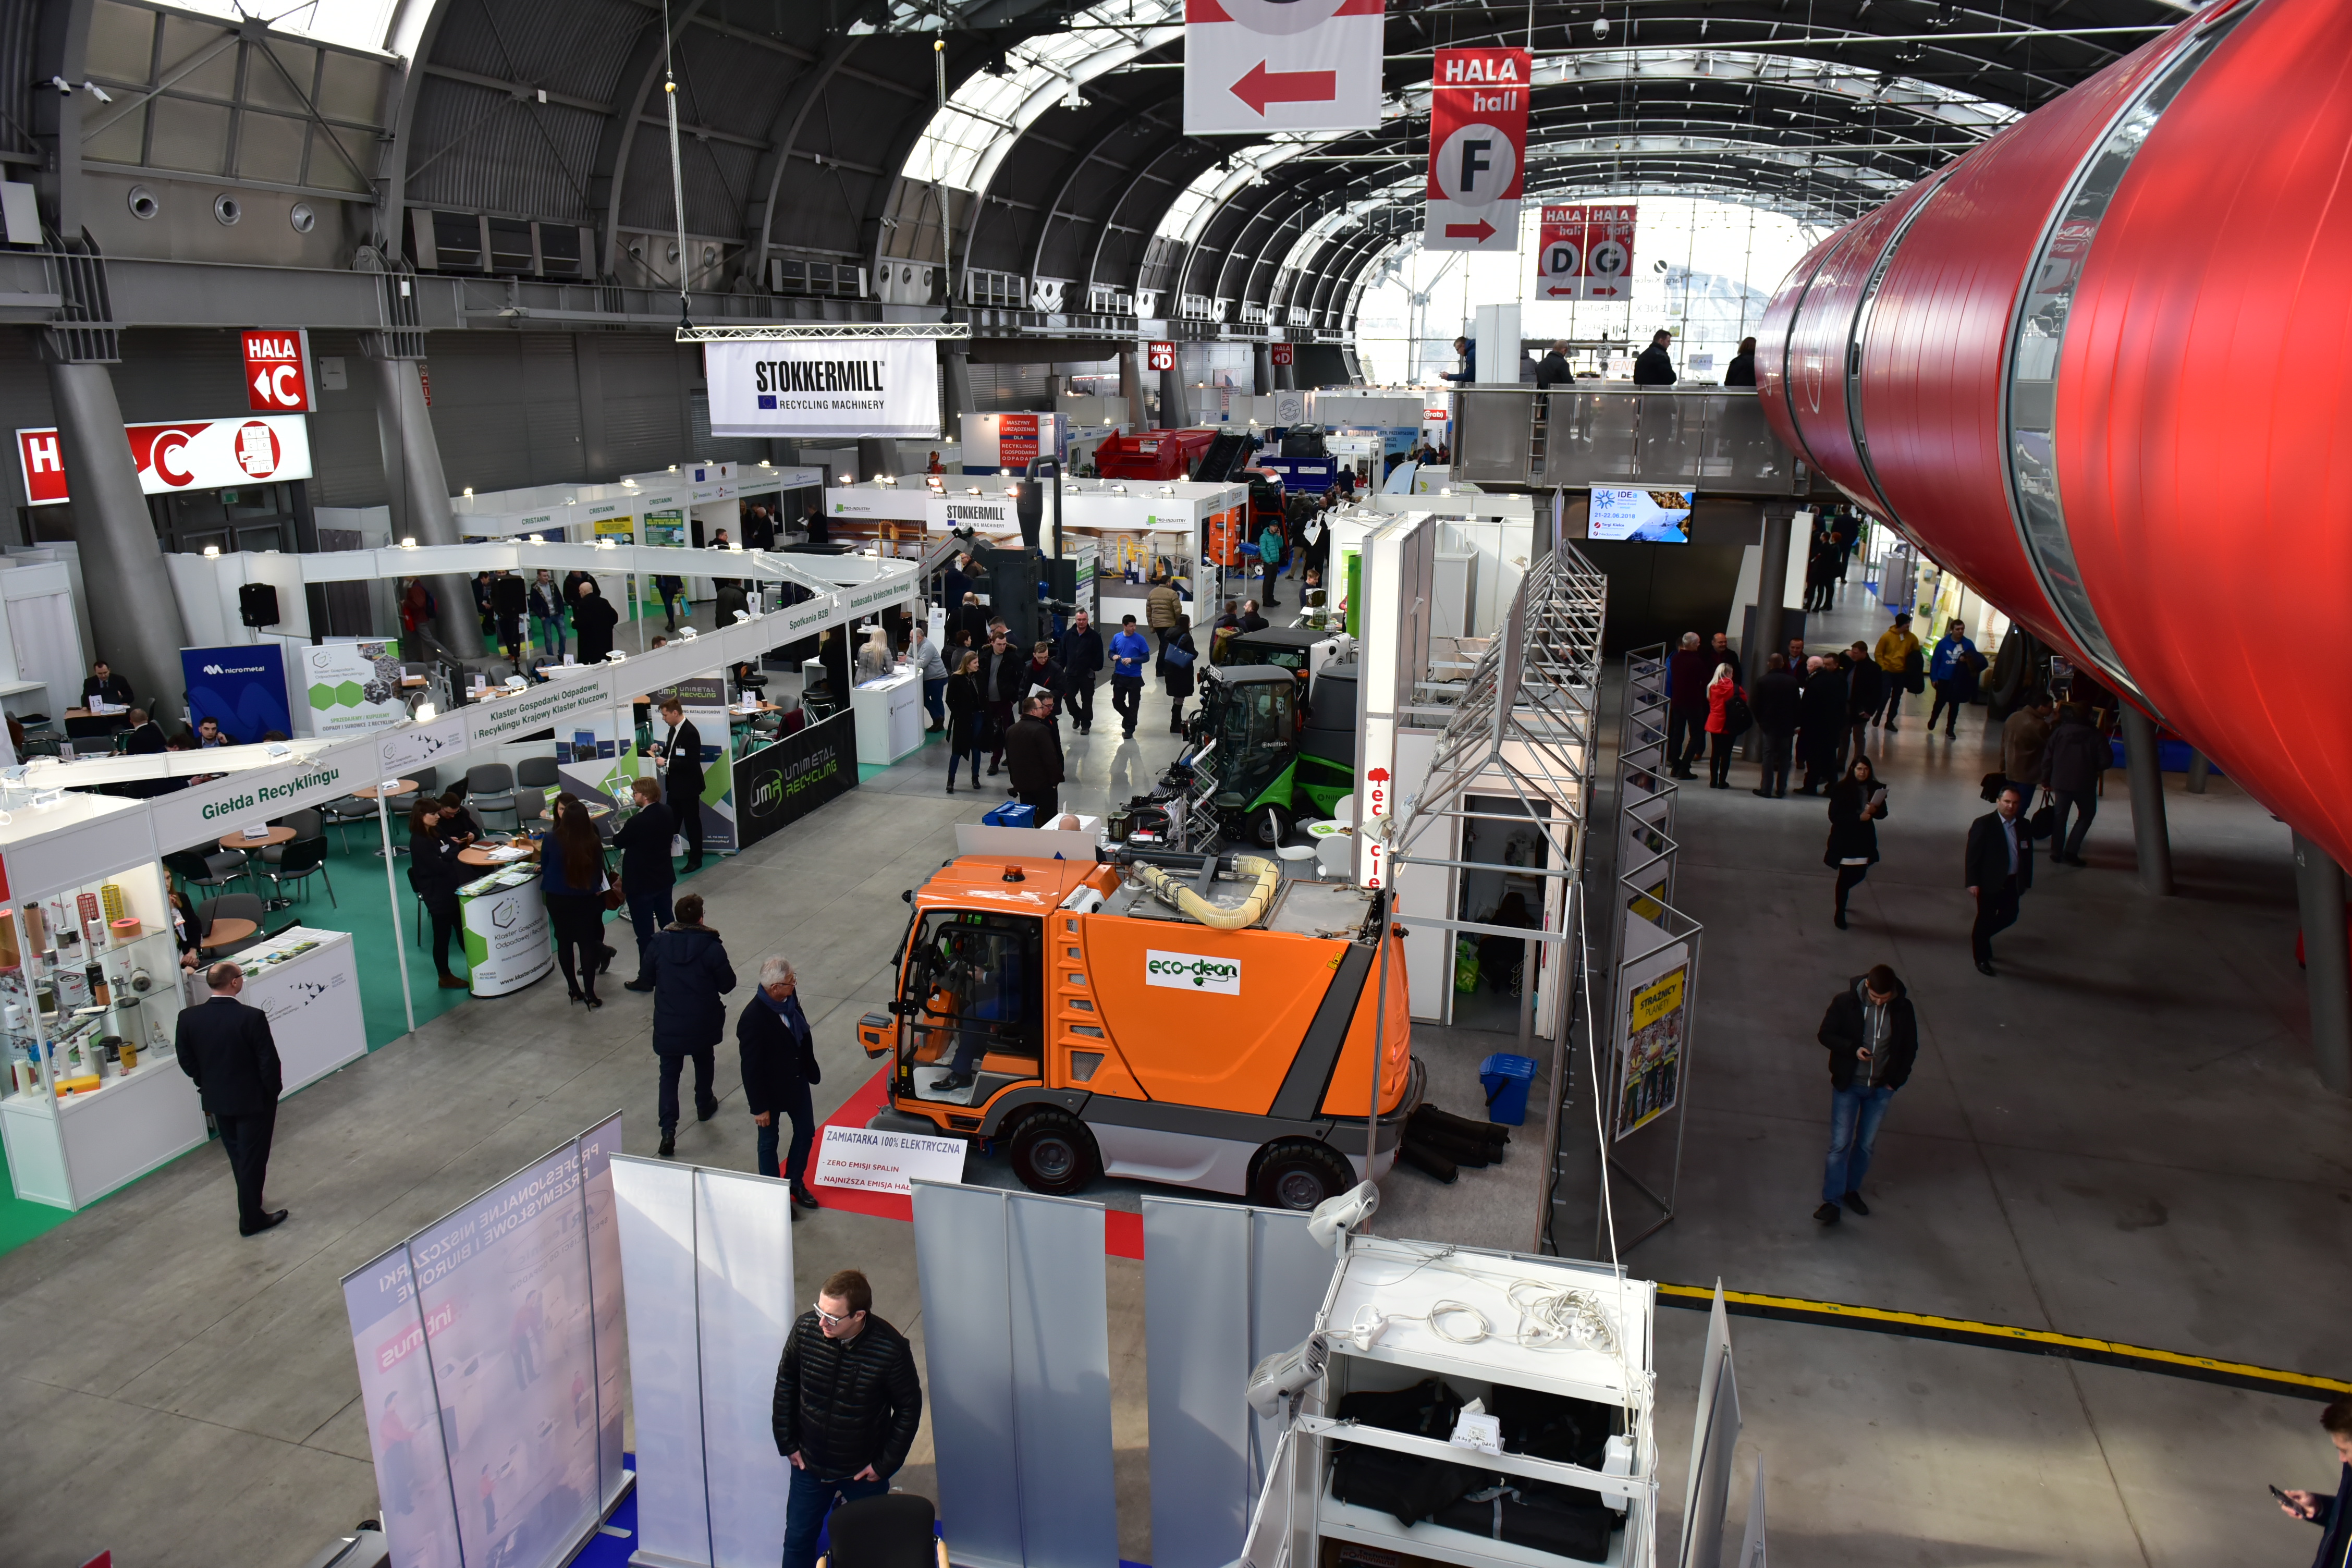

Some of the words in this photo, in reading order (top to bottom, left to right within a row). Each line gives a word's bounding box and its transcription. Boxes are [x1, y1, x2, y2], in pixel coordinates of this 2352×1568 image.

[1446, 58, 1518, 82] HALA
[1473, 91, 1517, 113] hall
[1460, 139, 1491, 192] F
[1546, 210, 1582, 222] HALA
[1594, 210, 1630, 221] HALA
[1559, 225, 1582, 236] hall
[1607, 225, 1630, 235] hall
[1551, 248, 1573, 273] D
[1596, 248, 1621, 273] G
[248, 339, 297, 359] HALA
[1150, 344, 1172, 352] HALA
[1160, 354, 1172, 369] D
[1281, 352, 1290, 364] D
[272, 364, 301, 406] C
[755, 360, 884, 393] STOKKERMILL
[780, 400, 829, 410] RECYCLING
[832, 400, 885, 409] MACHINERY
[150, 430, 195, 487] C
[589, 505, 615, 514] CRISTANINI
[650, 497, 672, 505] CRISTANINI
[522, 515, 550, 525] CRISTANINI
[947, 505, 1005, 521] STOKKERMILL
[850, 594, 873, 609] Ambasada
[873, 589, 892, 603] Królestwa
[893, 581, 910, 594] Norwegii
[789, 612, 817, 631] Spotkania
[818, 608, 829, 620] B2B
[479, 680, 483, 689] 7
[91, 699, 102, 708] 13
[491, 707, 517, 721] Klaster
[519, 692, 560, 713] Gospodarki
[562, 681, 599, 700] Odpadowej
[746, 696, 752, 704] 2
[330, 715, 362, 724] SPRZEDAJEMY
[474, 731, 476, 740] i
[479, 718, 520, 739] Recyklingu
[522, 709, 550, 724] Krajowy
[553, 701, 577, 715] Klaster
[578, 692, 608, 706] Kluczowy
[62, 747, 72, 756] 11
[785, 745, 836, 781] UNIMETAL
[786, 759, 838, 798] RECYCLING
[202, 794, 254, 820] Giełda
[258, 768, 339, 803] Recyklingu
[494, 929, 517, 940] Klaster
[495, 933, 530, 949] Odpadowej
[532, 921, 549, 935] Recykling
[1148, 959, 1238, 976] eco-clean
[1640, 983, 1677, 1010] STRAŻNICY
[1645, 997, 1670, 1018] PLANETY
[826, 1130, 878, 1146] ZAMIATARKA
[880, 1135, 899, 1148] 100%
[900, 1138, 960, 1154] ELEKTRYCZNA
[826, 1159, 847, 1167] ZERO
[849, 1161, 871, 1171] EMISJI
[872, 1164, 899, 1172] SPALIN
[824, 1175, 865, 1186] NAJNIŻSZA
[867, 1180, 892, 1189] EMISJA
